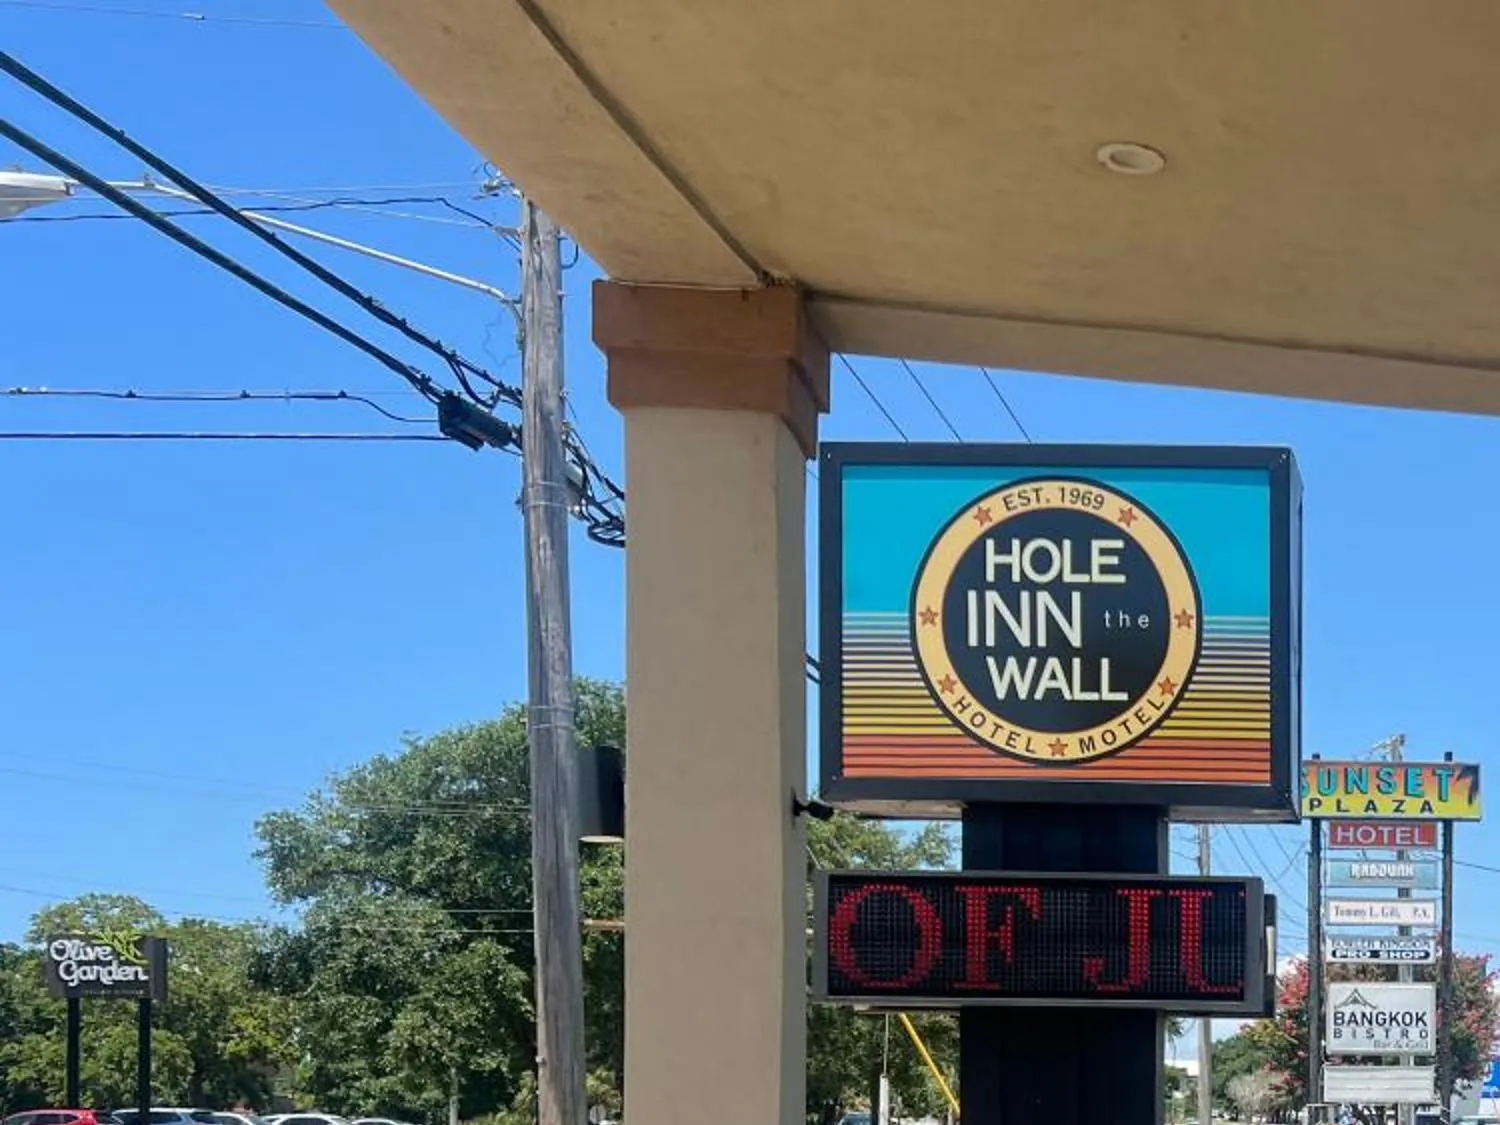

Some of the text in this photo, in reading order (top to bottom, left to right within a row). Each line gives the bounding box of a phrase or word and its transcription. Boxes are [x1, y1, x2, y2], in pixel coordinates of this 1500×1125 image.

[1002, 487, 1105, 511] EST. 1969
[985, 538, 1127, 584] HOLE
[967, 590, 1150, 649] INN the
[986, 656, 1128, 701] WALL
[954, 695, 1036, 755] HOTEL
[1079, 696, 1165, 755] MOTEL
[1309, 798, 1434, 813] PLAZA
[1336, 825, 1431, 845] HOTEL
[50, 939, 113, 961] Olive
[1335, 950, 1427, 959] PRO SHOP
[59, 960, 149, 987] Garden
[1333, 1011, 1428, 1027] BANGKOK
[1333, 1028, 1429, 1040] BISTRO
